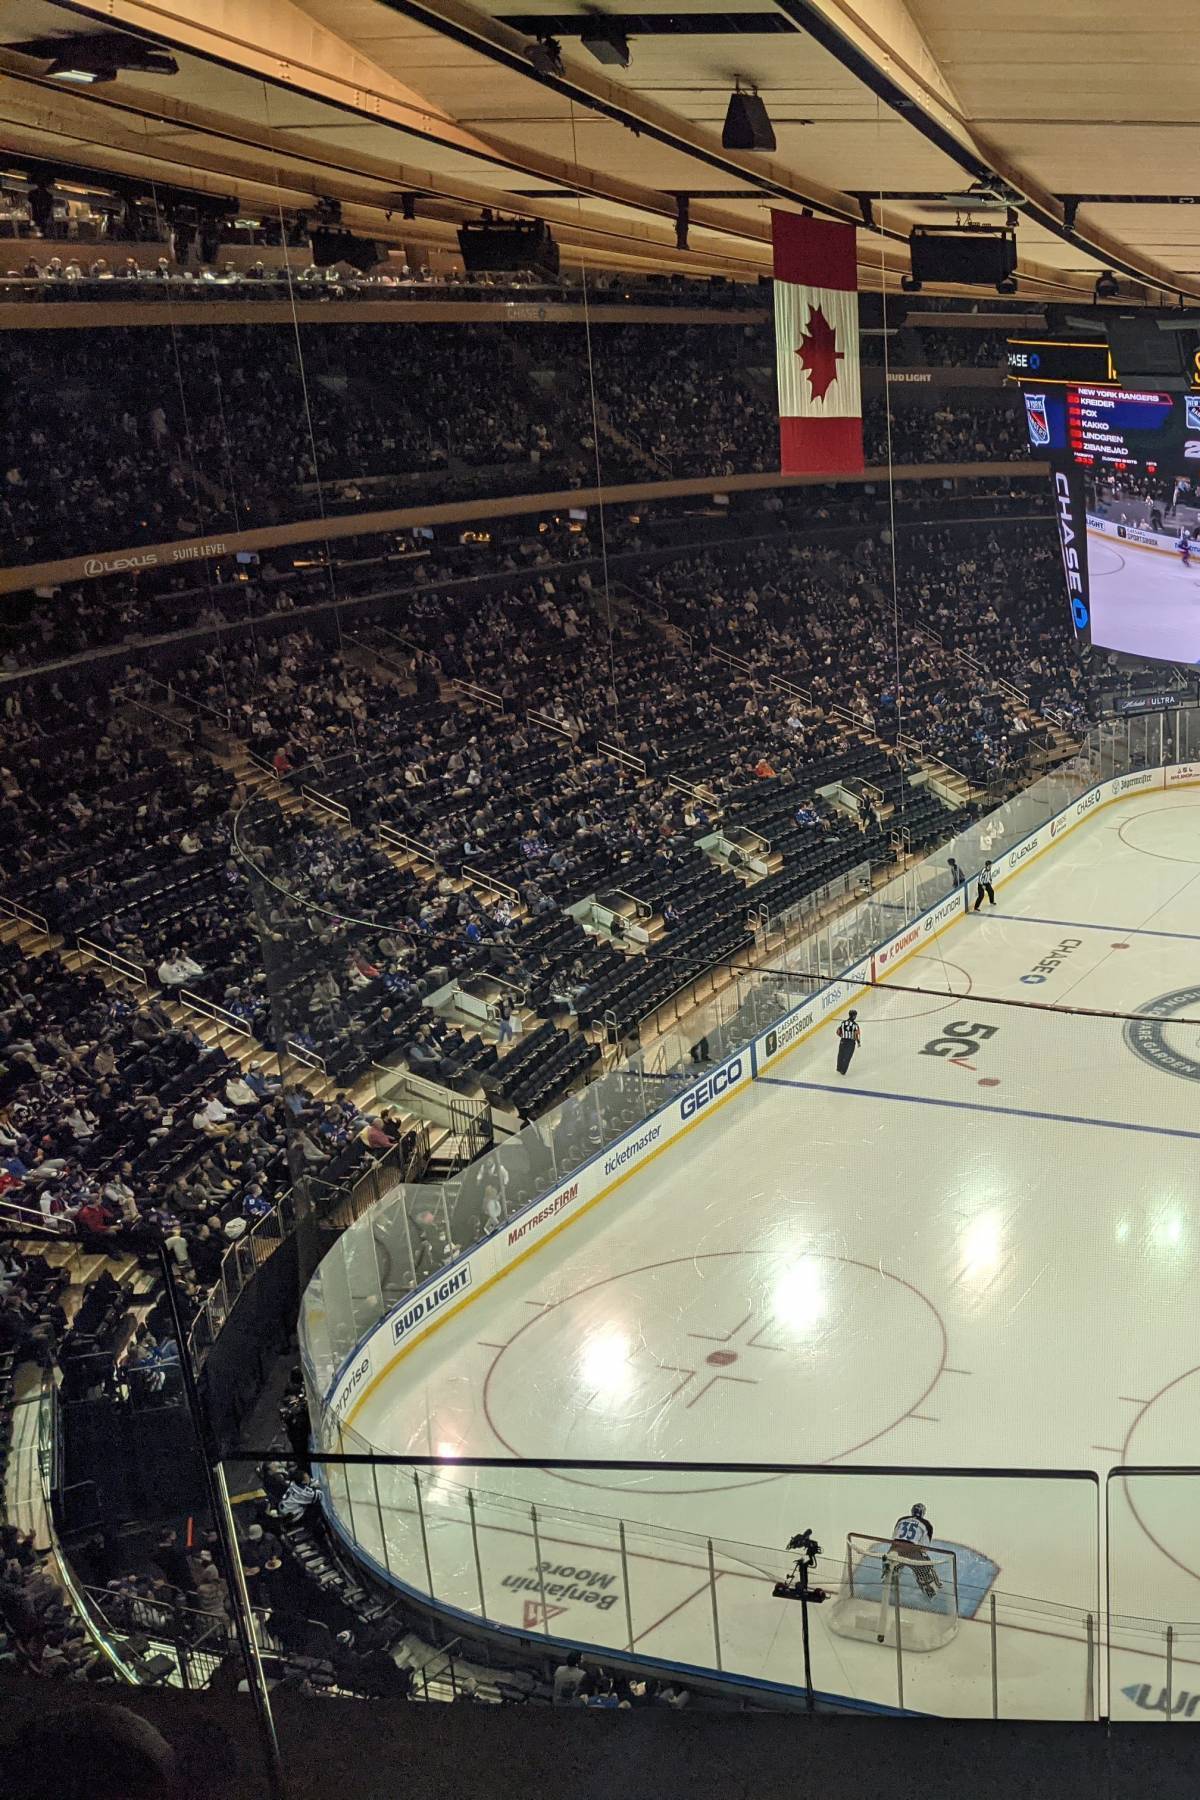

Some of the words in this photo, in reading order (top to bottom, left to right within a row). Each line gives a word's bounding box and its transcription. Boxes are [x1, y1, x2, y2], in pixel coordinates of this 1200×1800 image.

[906, 374, 932, 382] LIGHT
[1078, 388, 1095, 396] NEW
[1096, 389, 1117, 398] YORK
[1118, 392, 1159, 402] RANGERS
[1080, 398, 1115, 408] KREIDER
[1081, 409, 1097, 417] FOX
[1081, 420, 1109, 430] KAKKO
[1082, 431, 1123, 443] LINDGREN
[1083, 443, 1128, 455] ZIBANEJAD
[1056, 472, 1082, 594] CHASE
[104, 554, 158, 571] LEXUS
[173, 548, 199, 561] SUITE
[200, 543, 226, 556] LEVEL
[1151, 696, 1175, 705] ULTRA
[1076, 794, 1095, 815] CHASE
[1016, 838, 1038, 860] LEXUS
[934, 896, 960, 923] HYUNDAI
[1031, 938, 1082, 974] CHASE
[777, 1012, 813, 1048] SPORTSBOOK
[918, 1020, 1000, 1058] 5G
[1143, 1041, 1196, 1072] GARDEN
[681, 1058, 742, 1120] GEICO
[604, 1124, 662, 1176] ticketmaster
[507, 1183, 578, 1246] MATTRESSFIRM
[394, 1305, 424, 1338] BUD
[426, 1267, 468, 1314] LIGHT
[899, 1521, 919, 1540] 35
[535, 1561, 617, 1590] Moore
[501, 1574, 619, 1611] Benjamin
